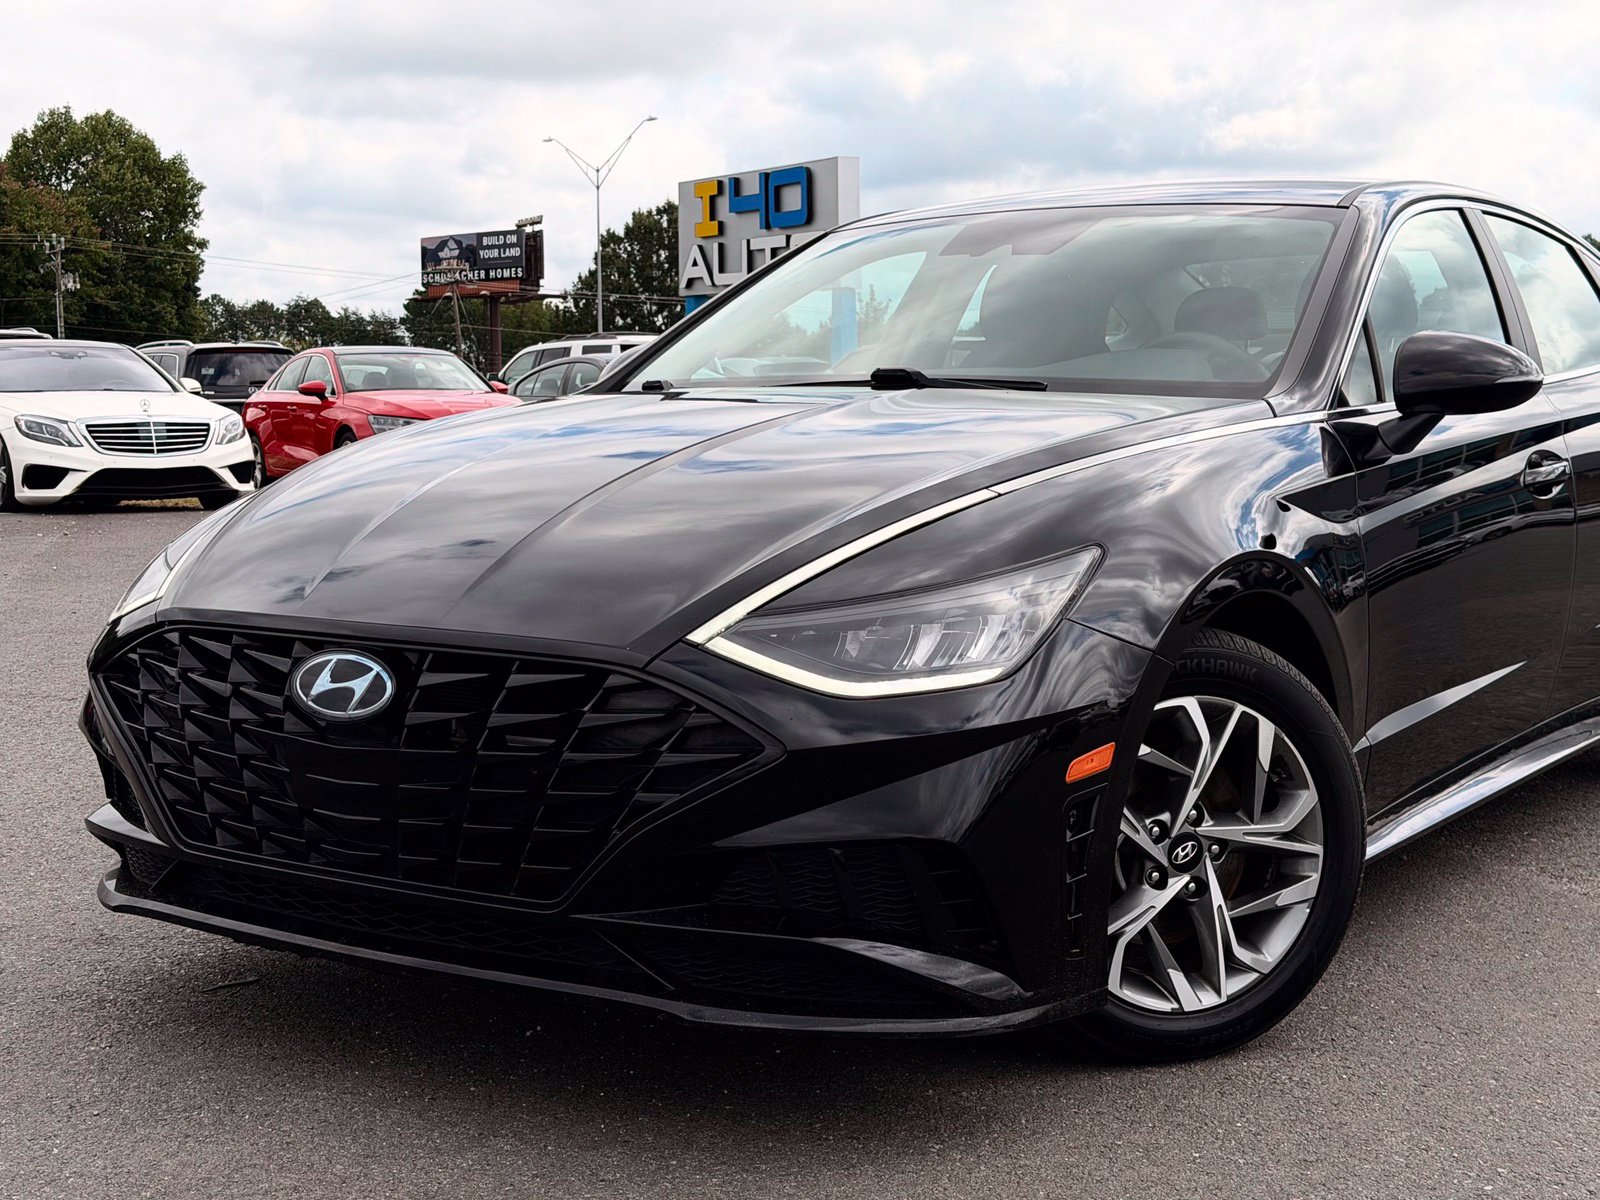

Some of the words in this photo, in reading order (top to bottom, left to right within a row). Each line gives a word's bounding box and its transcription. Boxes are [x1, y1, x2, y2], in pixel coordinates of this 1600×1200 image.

[482, 235, 504, 246] BUILD
[506, 234, 517, 244] ON
[479, 249, 499, 259] YOUR
[501, 247, 521, 257] LAND
[679, 231, 829, 289] AUT
[489, 267, 523, 278] HOMES
